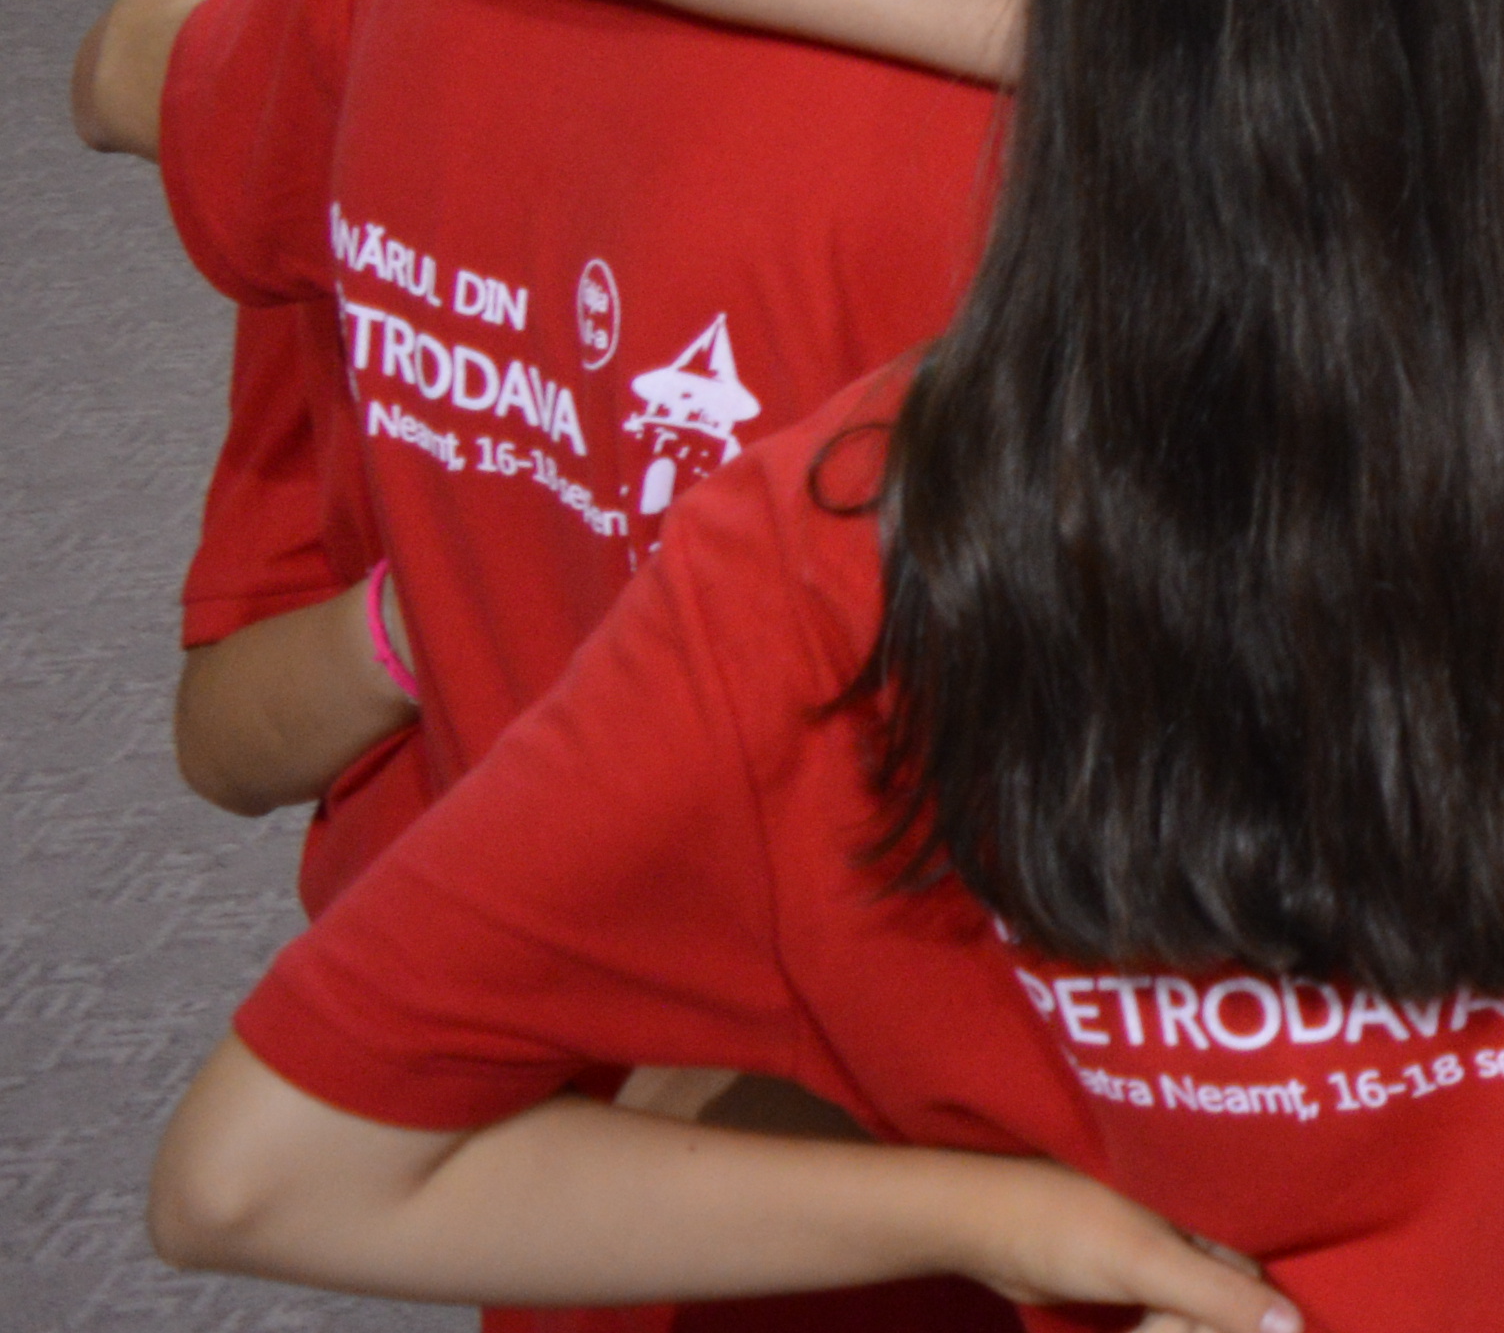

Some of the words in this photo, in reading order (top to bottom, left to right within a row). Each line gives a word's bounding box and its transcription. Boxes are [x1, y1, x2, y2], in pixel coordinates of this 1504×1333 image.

[329, 201, 443, 308] NĂRUL
[452, 268, 529, 332] DIN
[337, 293, 588, 457] TRODAVA
[1156, 1072, 1322, 1123] Neamț,
[1326, 1051, 1466, 1113] 16-18
